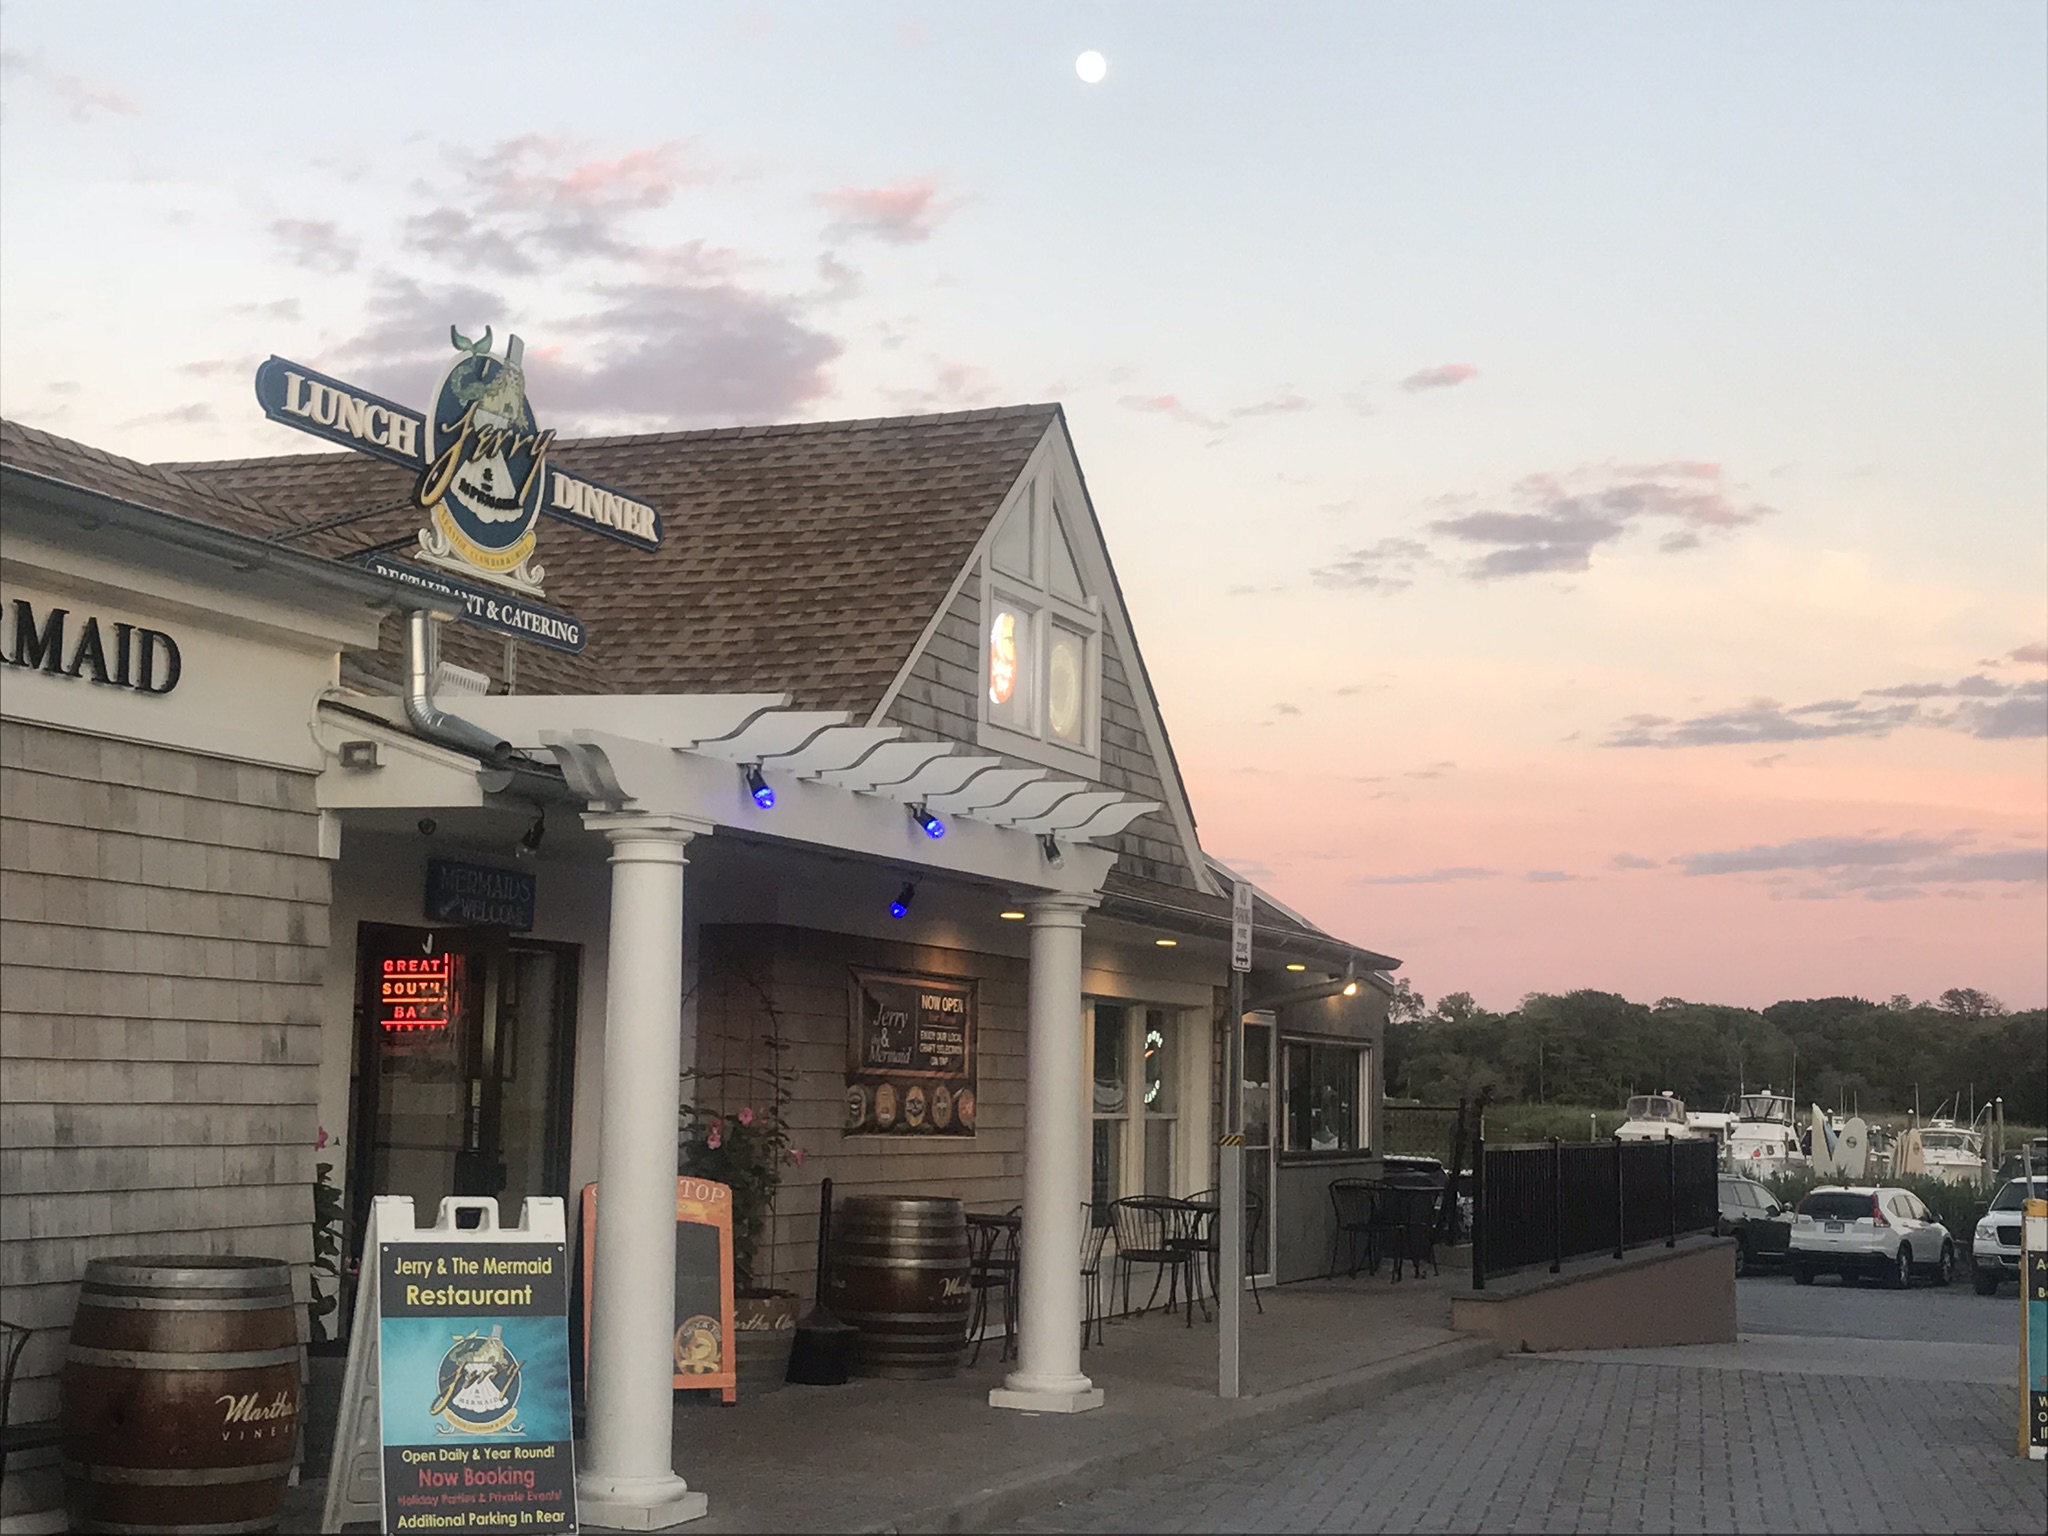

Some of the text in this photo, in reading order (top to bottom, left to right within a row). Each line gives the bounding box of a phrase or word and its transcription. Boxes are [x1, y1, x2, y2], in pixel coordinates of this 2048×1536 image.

[281, 371, 420, 458] LUNCH
[420, 401, 557, 506] Jerry
[551, 471, 659, 542] DINNER
[486, 600, 499, 621] &
[501, 604, 579, 644] CATERING
[0, 599, 181, 693] MAID
[441, 865, 531, 904] MERMAIDS
[383, 959, 441, 972] GREAT
[921, 994, 964, 1014] NOW OPEN
[873, 1003, 909, 1034] Jerry
[881, 1027, 890, 1048] &
[919, 1042, 936, 1054] CRAFT
[936, 1031, 947, 1042] OUR
[947, 1032, 963, 1043] LOCAL
[868, 1045, 913, 1064] Mermaid
[680, 1179, 726, 1203] TOP
[394, 1256, 552, 1279] Jerry & The Mermaid
[406, 1284, 533, 1306] Restaurant
[734, 1311, 770, 1330] artha
[429, 1360, 527, 1415] Jerry
[402, 1446, 555, 1464] Open Daily & Year Round!
[419, 1466, 535, 1489] Now Booking
[398, 1495, 439, 1507] Holiday
[441, 1493, 476, 1505] Parties
[478, 1492, 486, 1503] &
[489, 1491, 525, 1503] Private
[398, 1510, 566, 1529] Additional Parking In Rear
